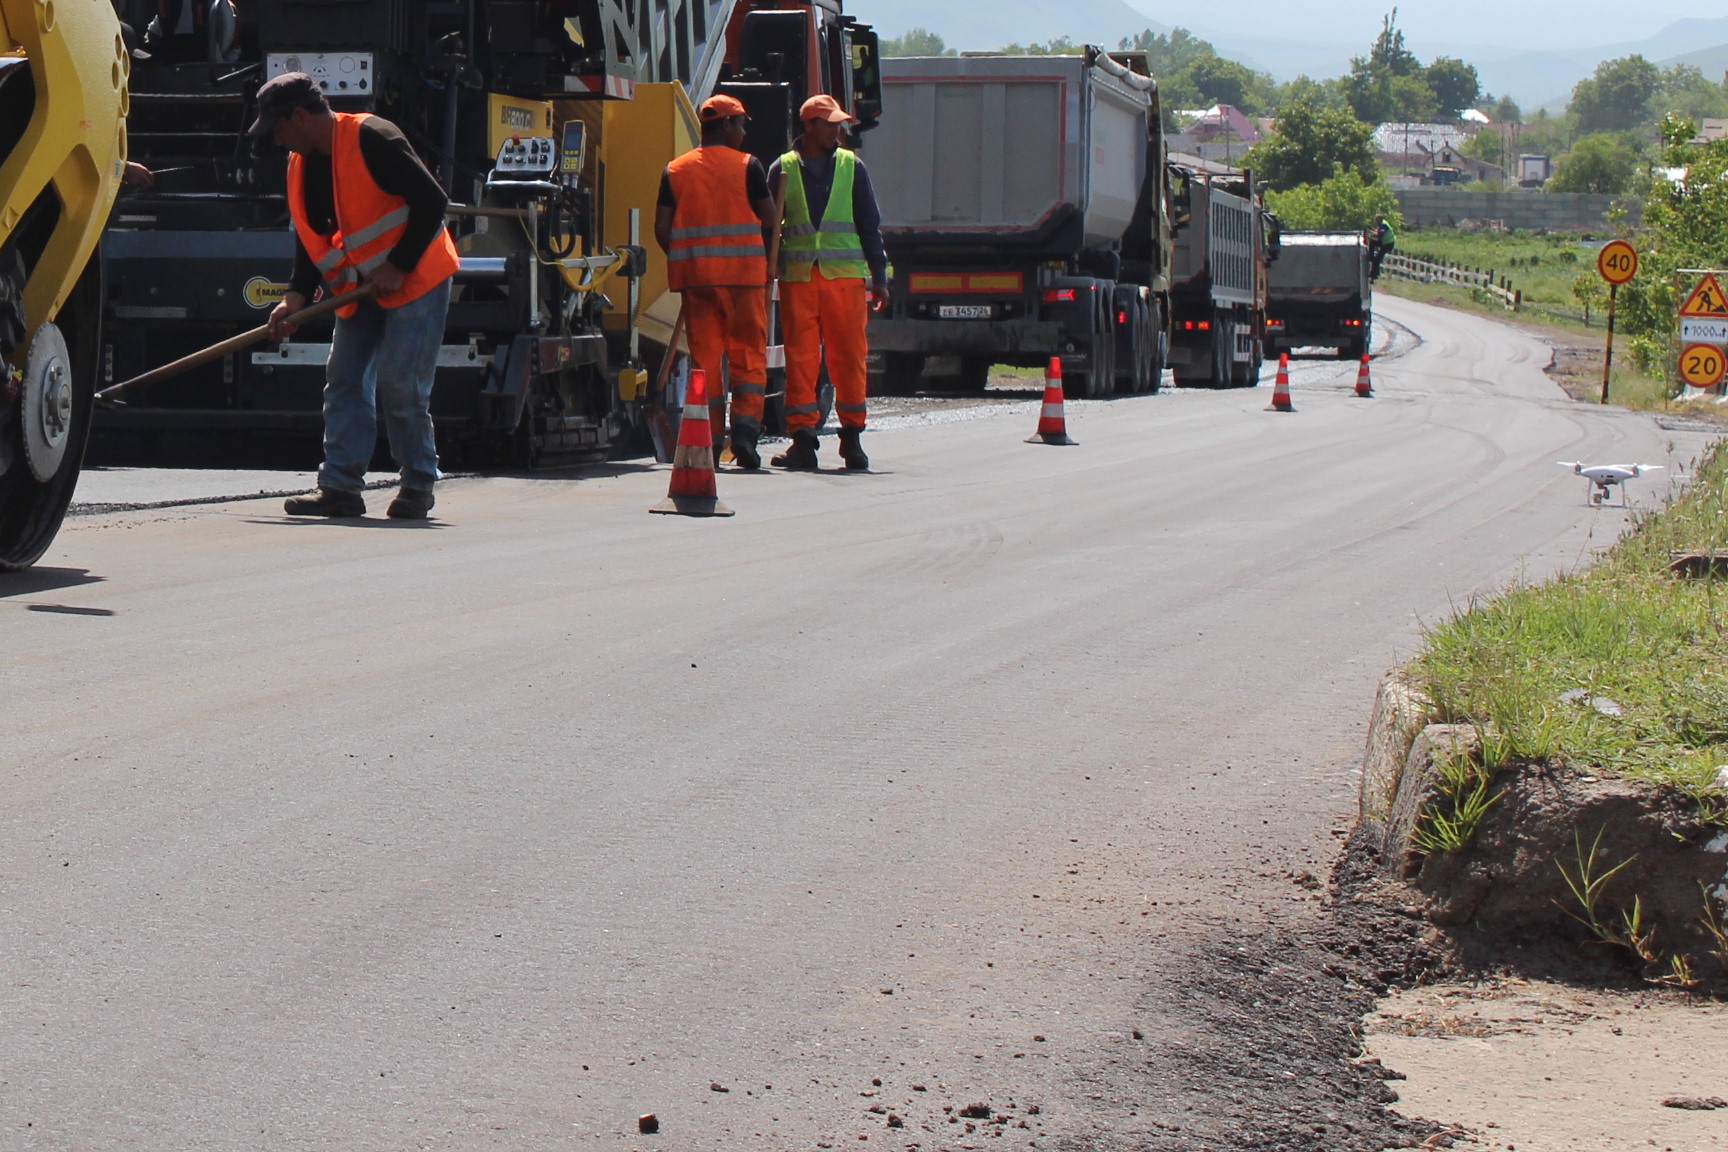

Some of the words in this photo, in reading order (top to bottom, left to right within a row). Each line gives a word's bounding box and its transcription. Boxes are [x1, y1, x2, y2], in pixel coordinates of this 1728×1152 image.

[1606, 253, 1630, 272] 40
[1692, 325, 1715, 337] 1000
[1688, 356, 1717, 375] 20
